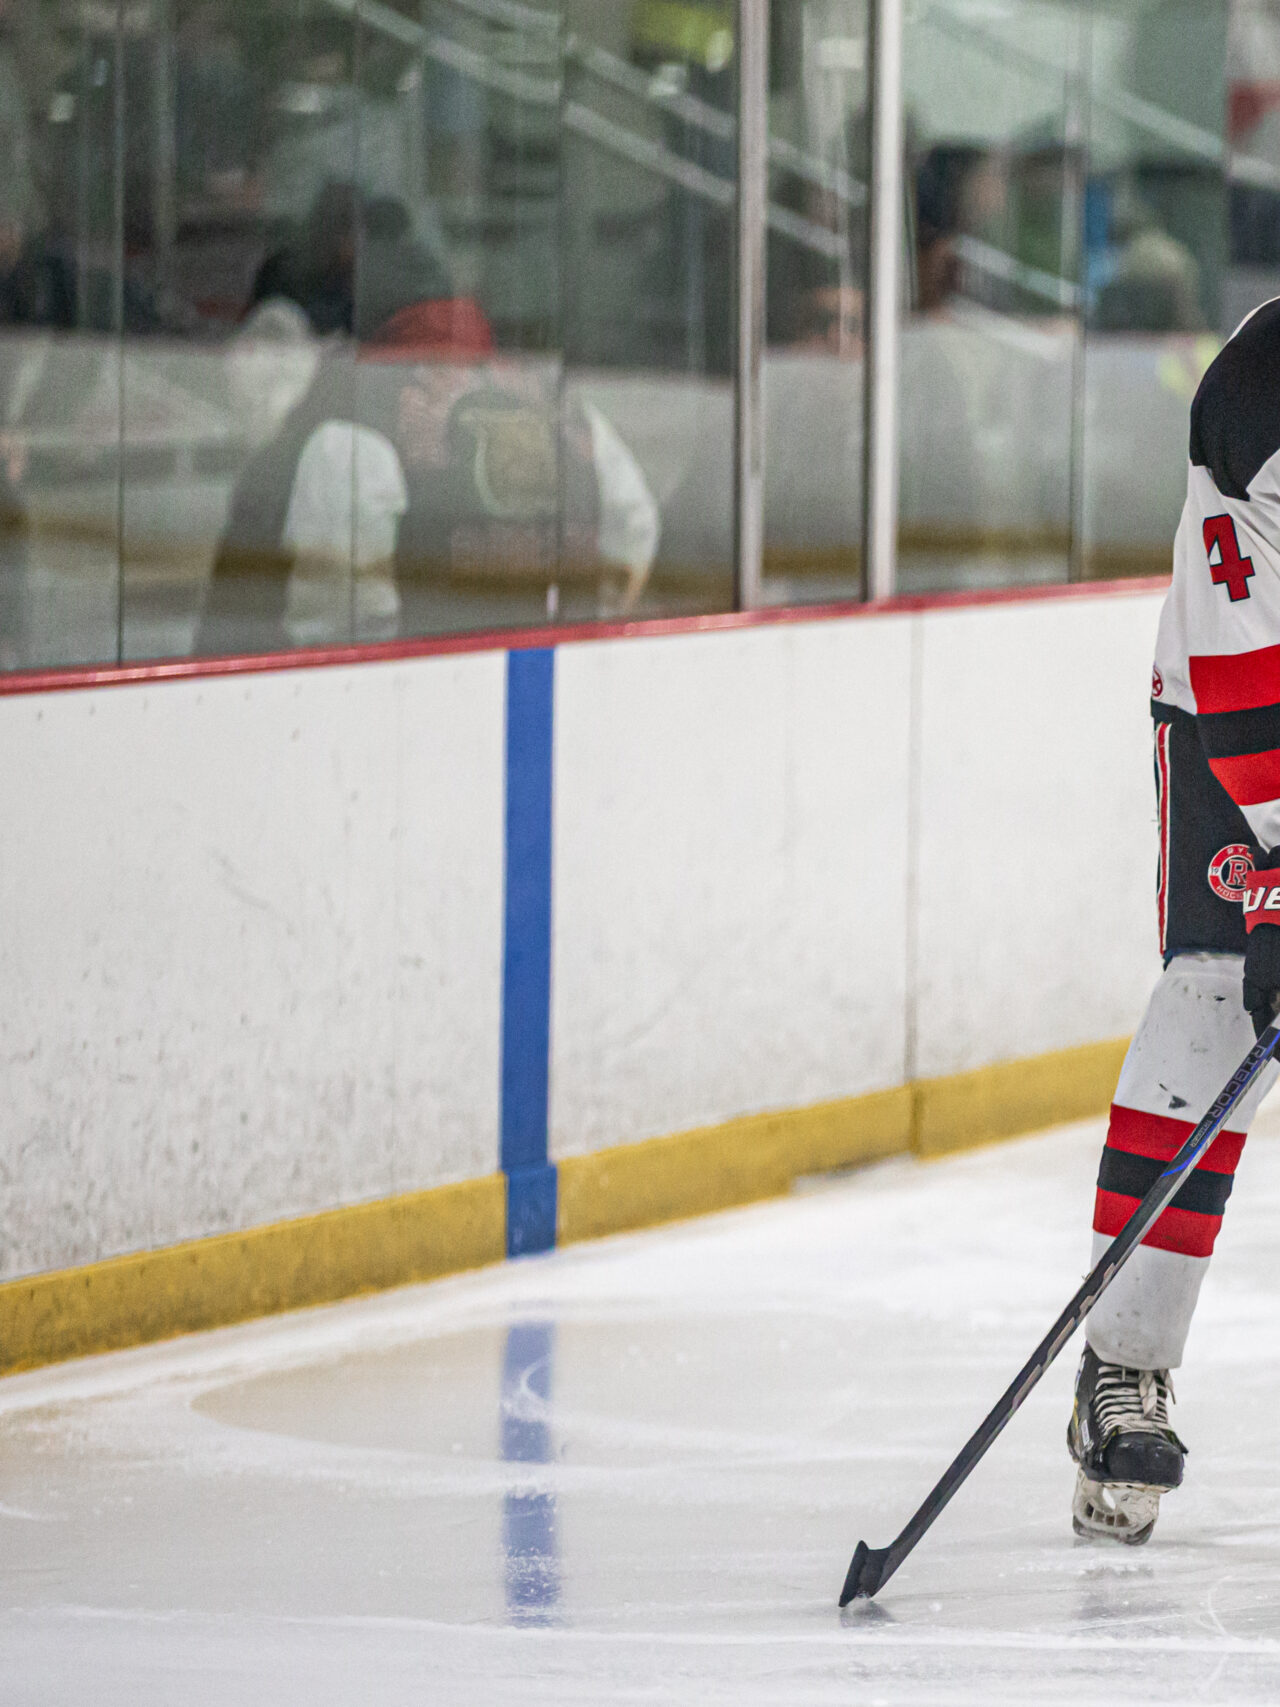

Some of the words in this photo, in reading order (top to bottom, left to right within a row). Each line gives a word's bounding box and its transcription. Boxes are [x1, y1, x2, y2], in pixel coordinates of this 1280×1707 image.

[1202, 513, 1256, 602] 4
[1226, 859, 1247, 886] R
[1208, 1045, 1267, 1118] RIBCOR
